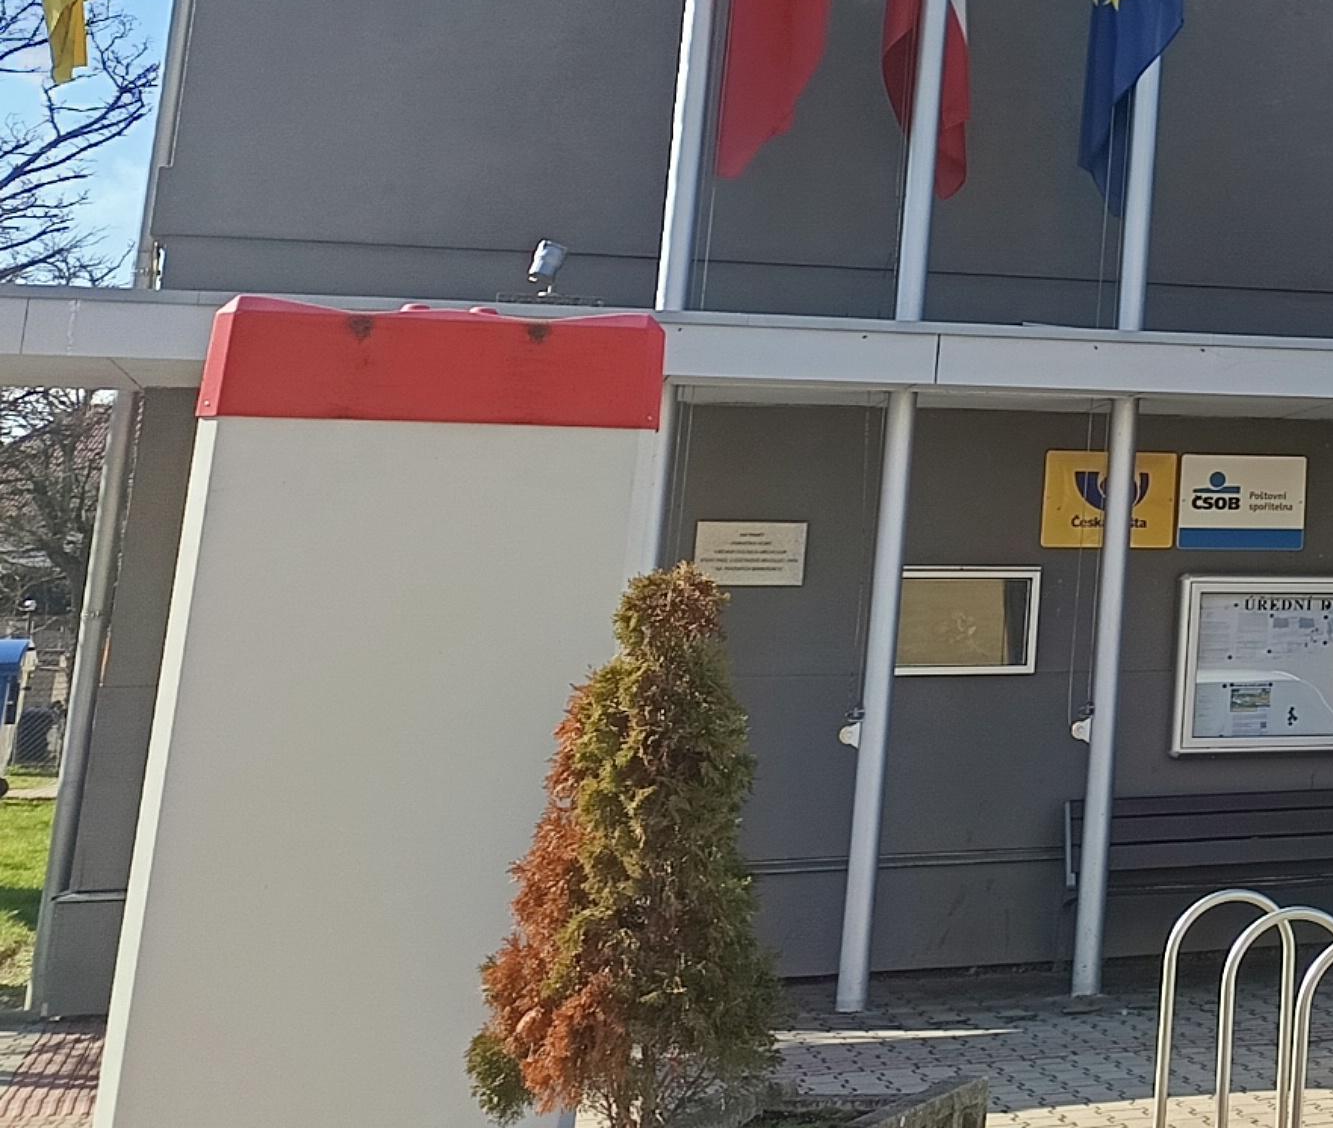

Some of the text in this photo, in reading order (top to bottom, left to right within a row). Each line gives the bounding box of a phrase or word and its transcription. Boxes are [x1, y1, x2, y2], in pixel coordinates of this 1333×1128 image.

[1191, 494, 1241, 510] ČSOB
[1071, 514, 1104, 528] Česk
[1244, 595, 1313, 611] ÚŘEDNÍ
